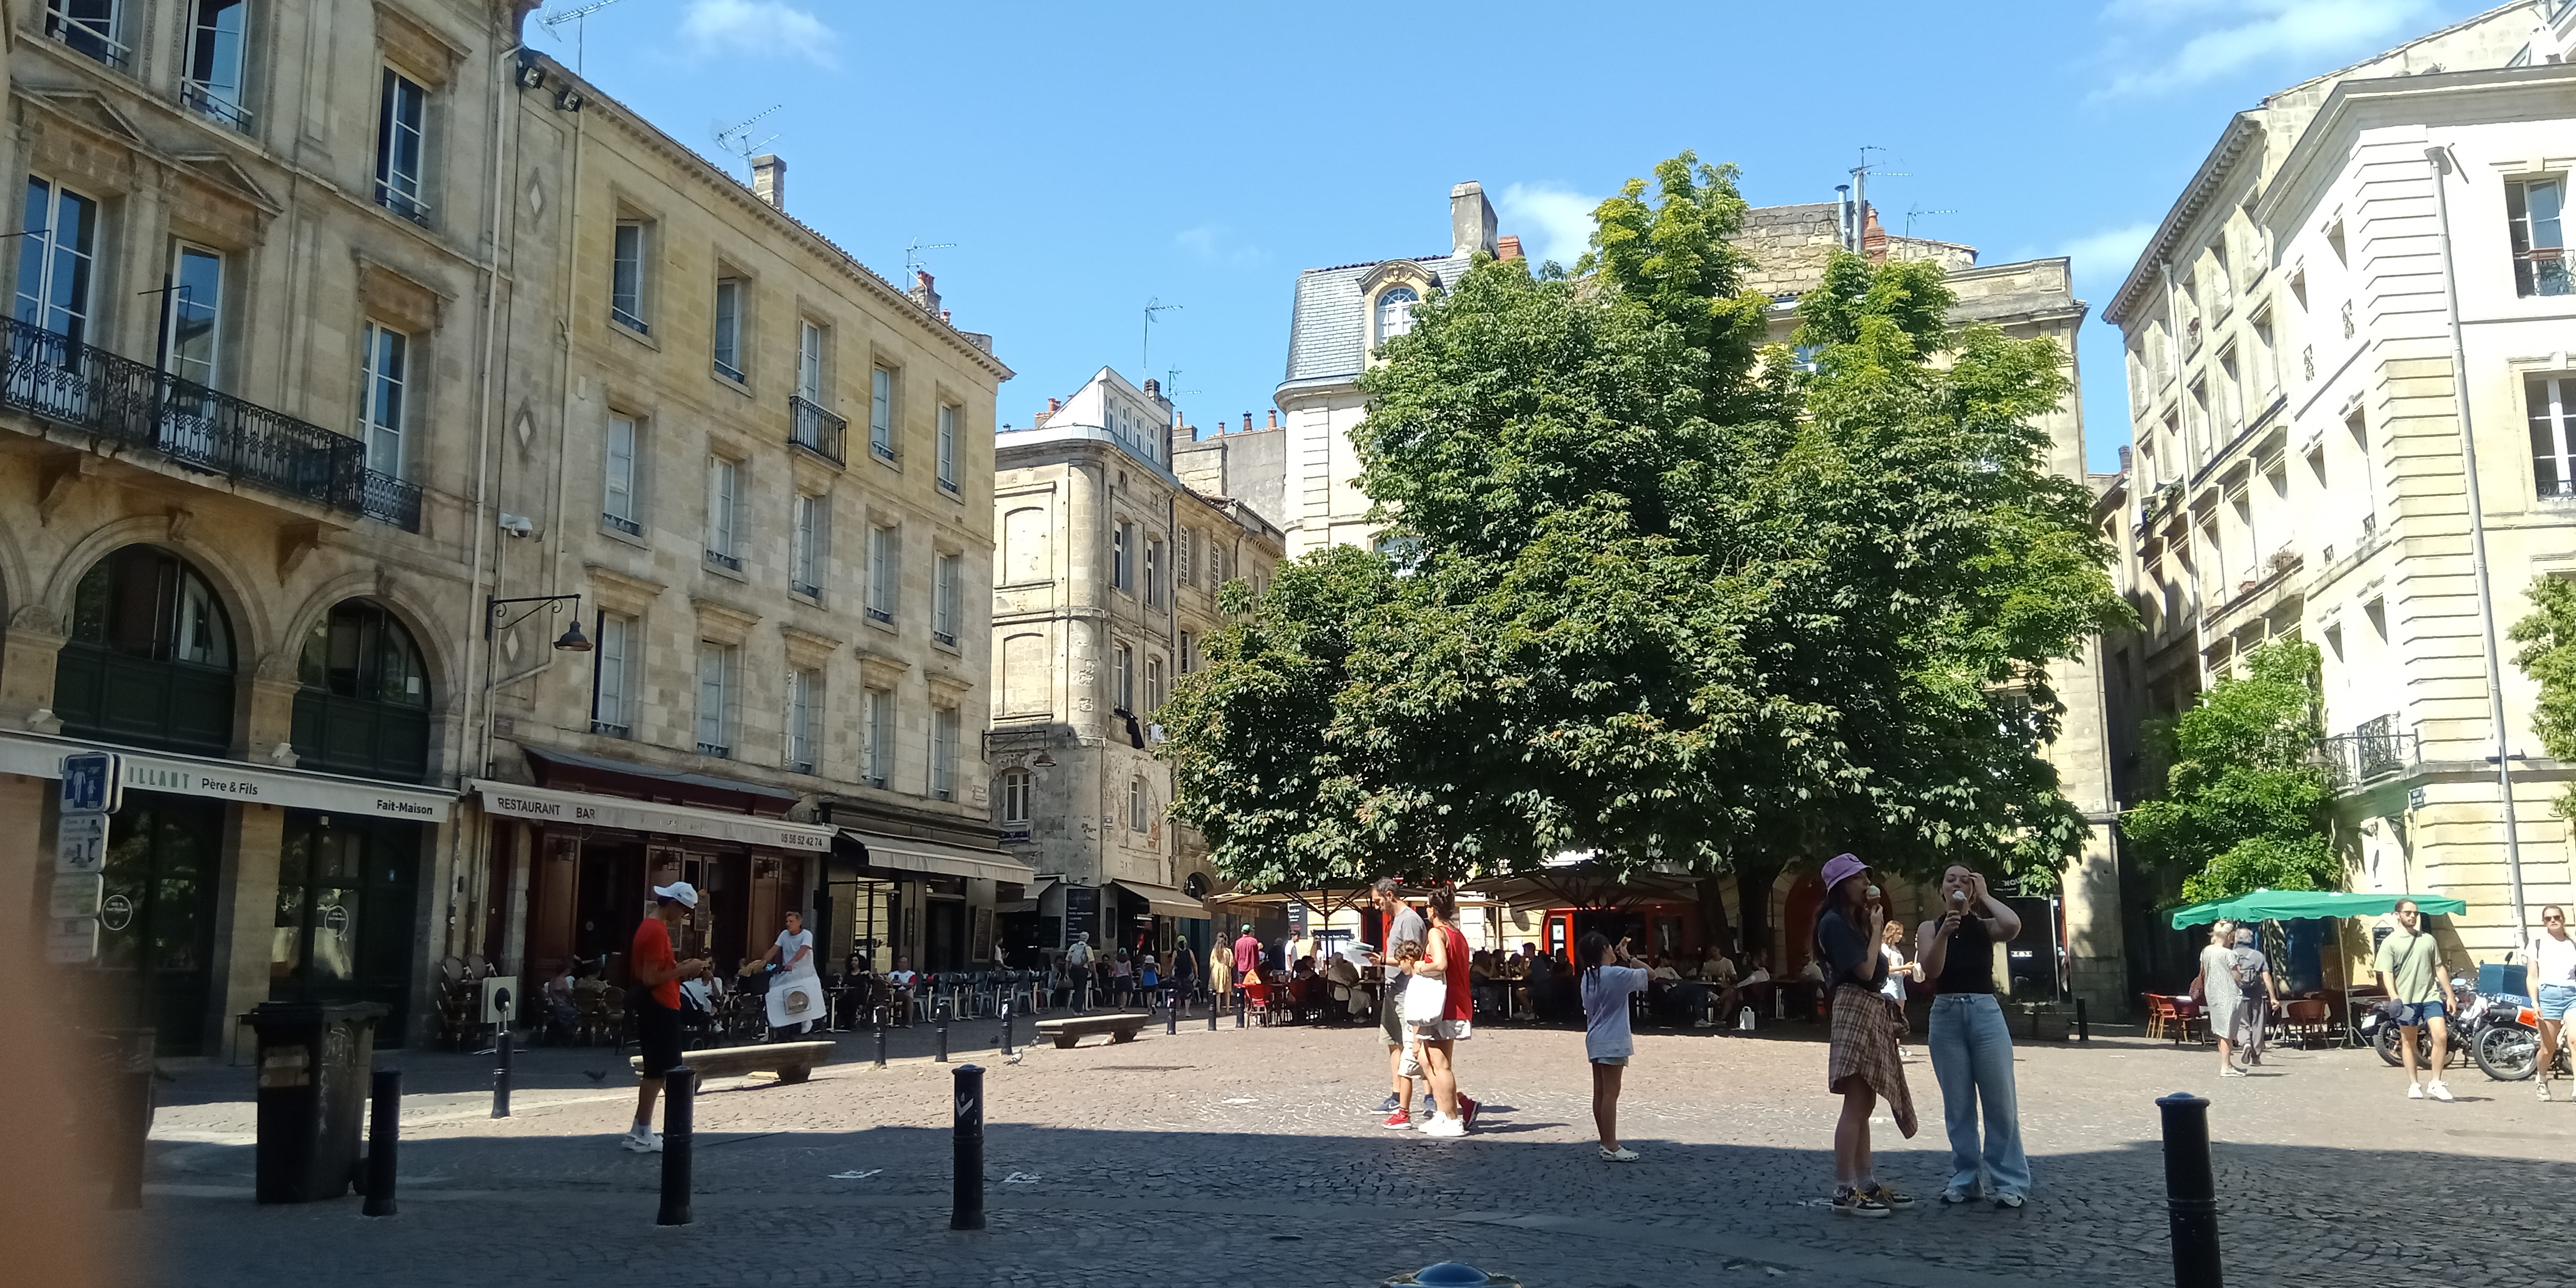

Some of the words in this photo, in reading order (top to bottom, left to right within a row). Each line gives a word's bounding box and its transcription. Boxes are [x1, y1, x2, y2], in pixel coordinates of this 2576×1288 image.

[202, 778, 227, 792] Père
[229, 782, 236, 792] &
[239, 783, 258, 795] Fils
[376, 799, 433, 815] Fait-Maison
[498, 797, 561, 816] RESTAURANT
[576, 807, 596, 819] BAR
[781, 834, 788, 842] 05
[798, 836, 804, 845] 52
[806, 837, 813, 846] 42
[815, 837, 822, 846] 74
[2506, 995, 2521, 1004] 125
